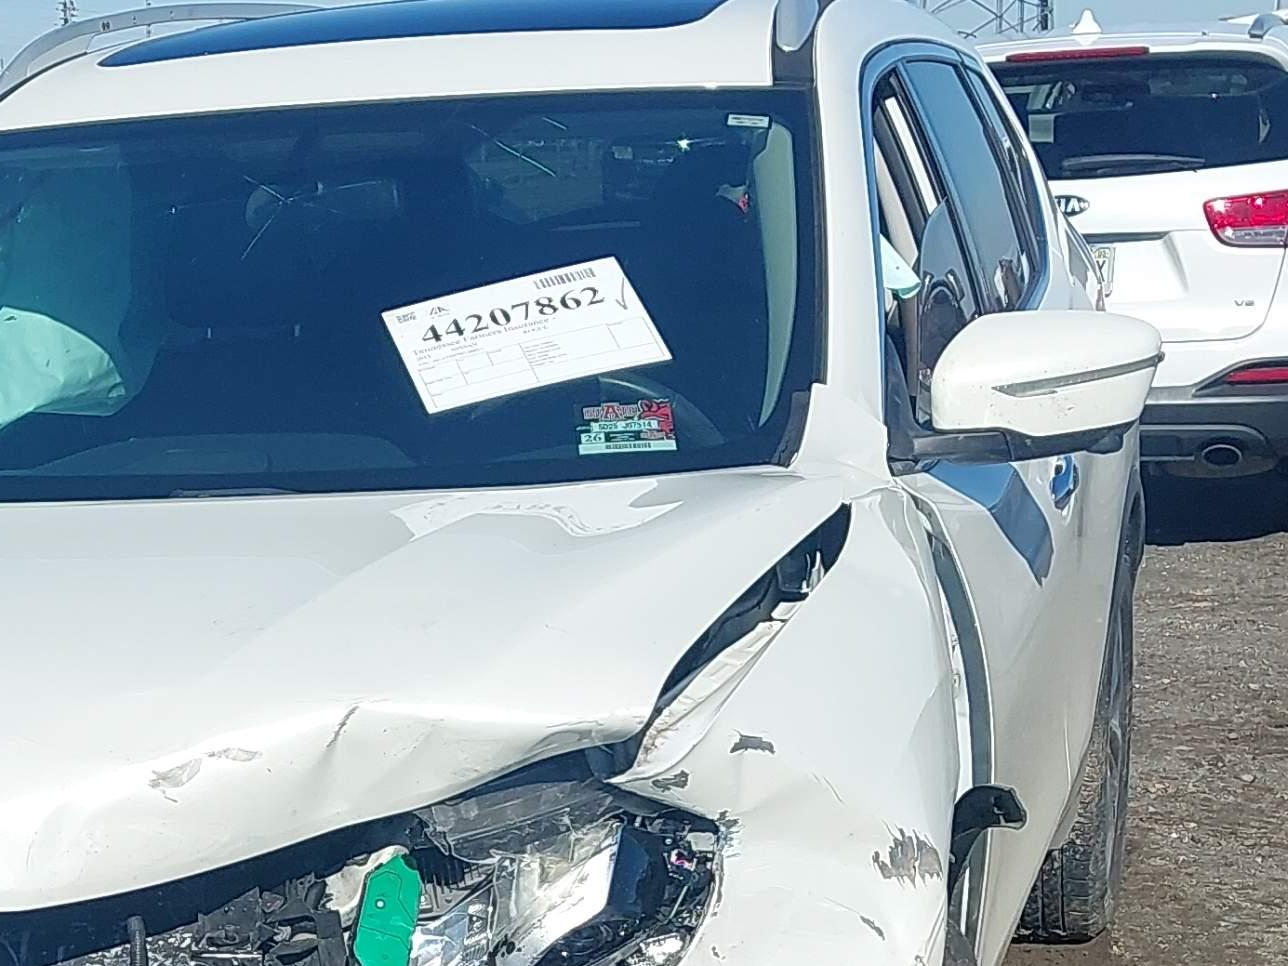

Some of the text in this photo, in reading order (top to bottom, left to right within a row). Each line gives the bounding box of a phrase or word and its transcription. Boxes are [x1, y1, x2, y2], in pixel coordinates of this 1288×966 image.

[1055, 198, 1080, 212] IA
[422, 286, 605, 342] 44207862
[584, 434, 602, 442] 26
